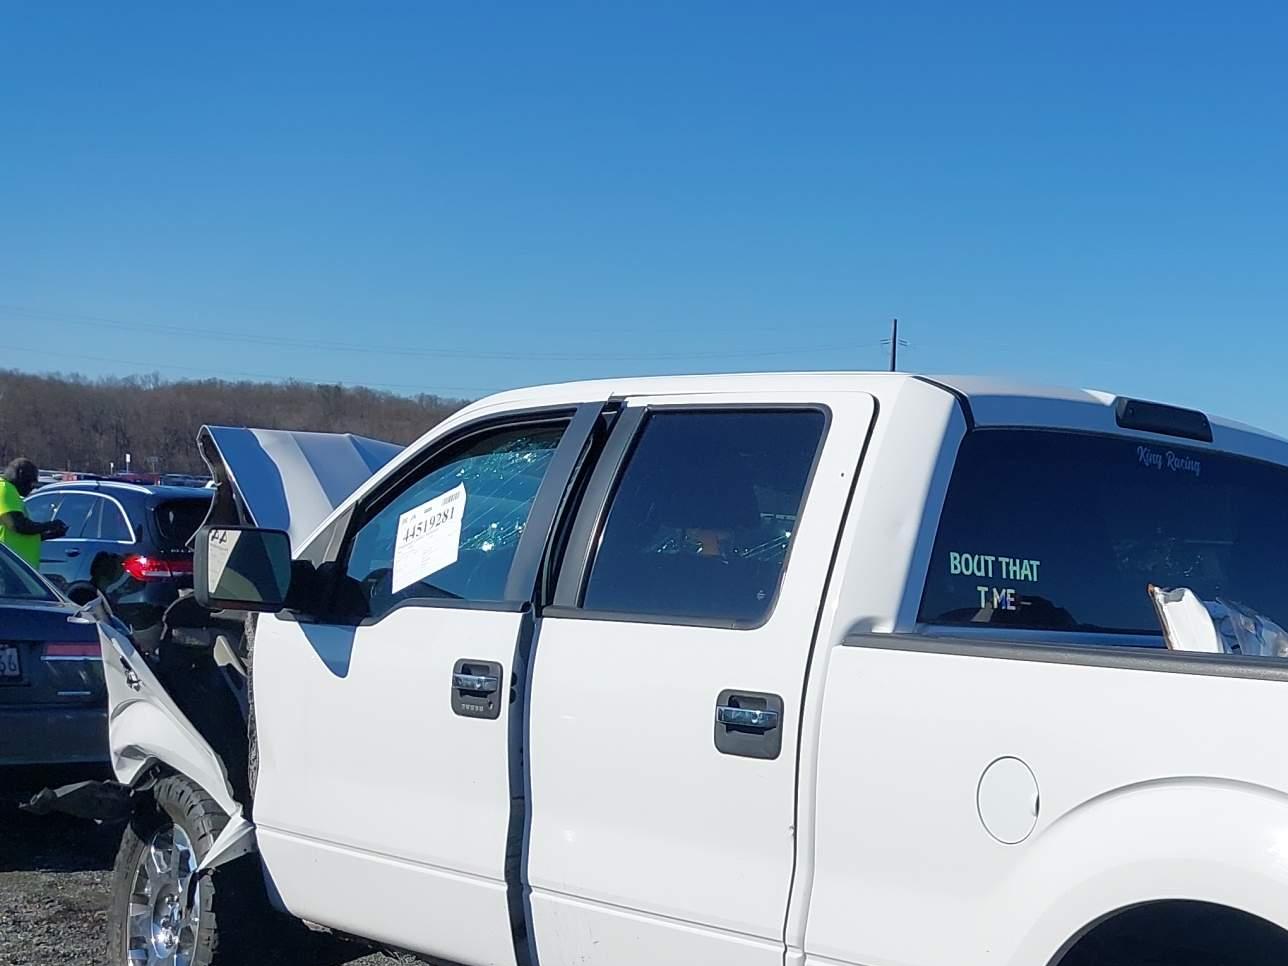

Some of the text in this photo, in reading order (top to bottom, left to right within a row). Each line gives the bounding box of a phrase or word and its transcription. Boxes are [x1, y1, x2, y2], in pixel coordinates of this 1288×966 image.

[402, 505, 456, 543] 44519281
[949, 551, 1041, 582] BOUT THAT
